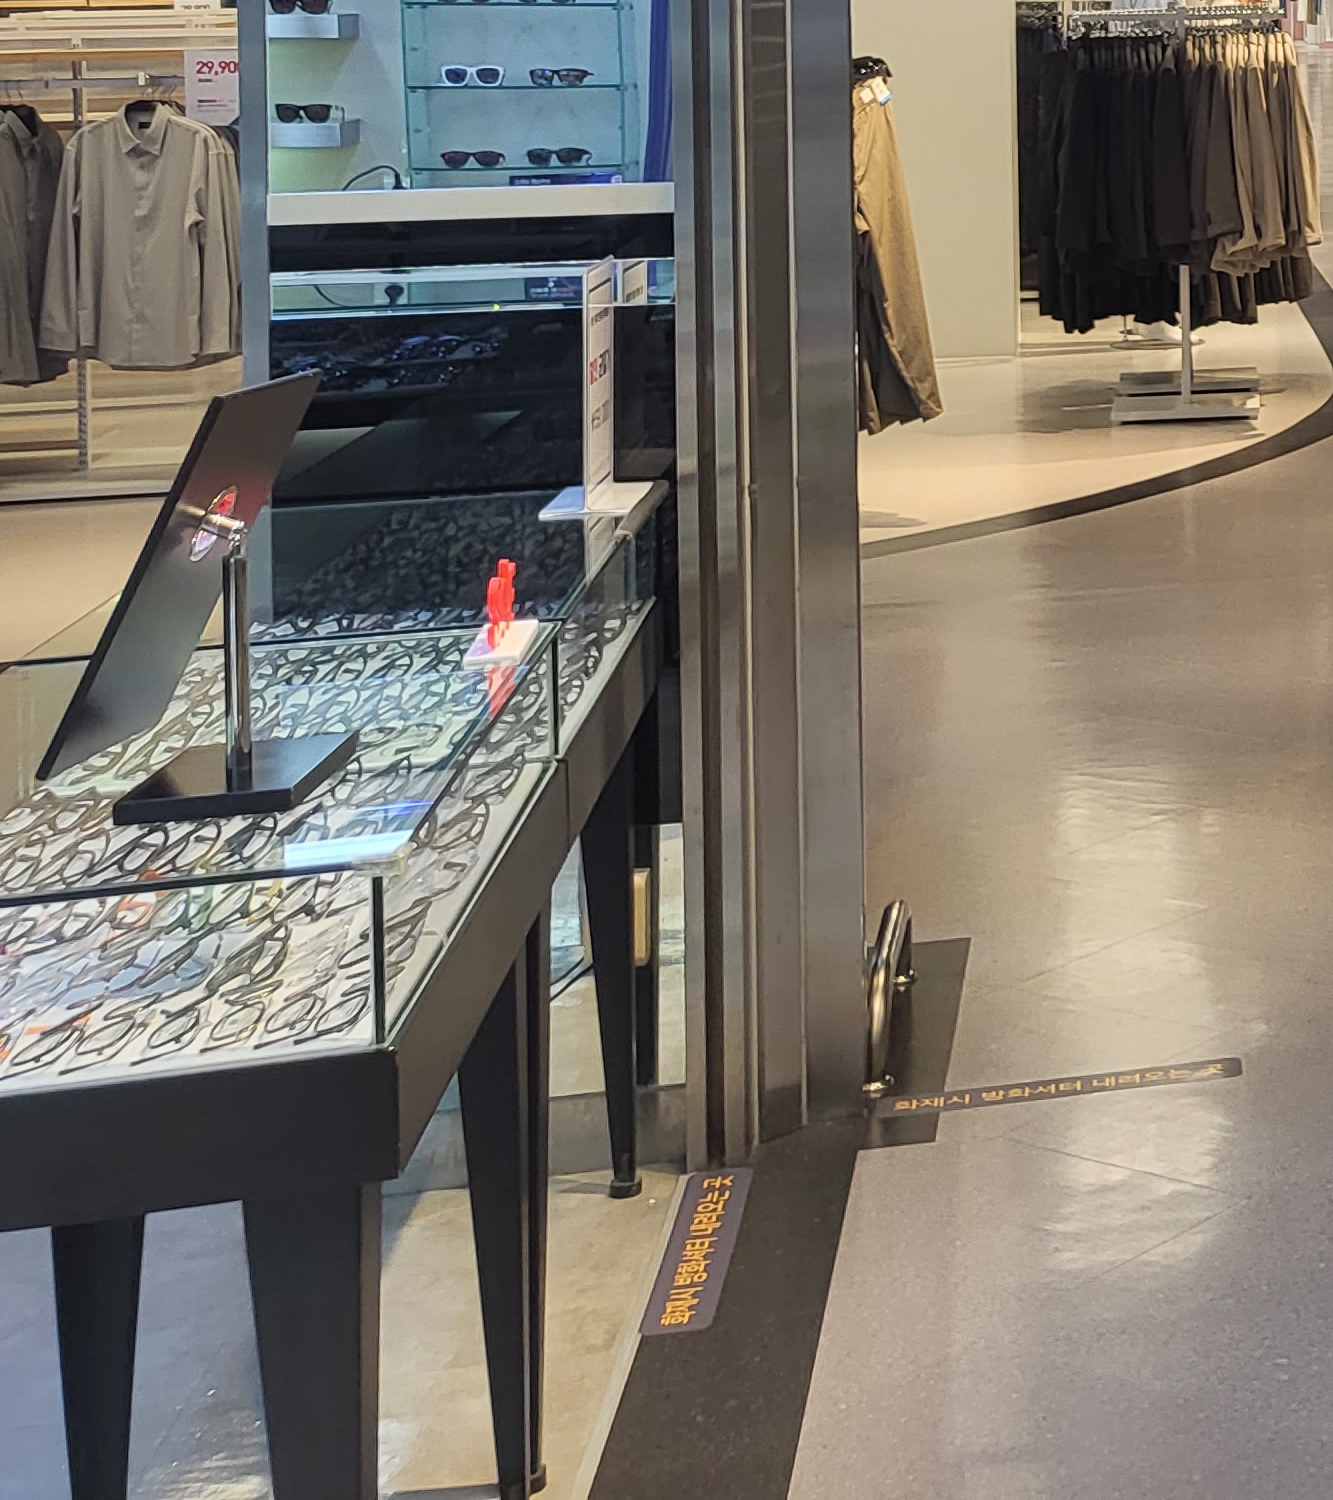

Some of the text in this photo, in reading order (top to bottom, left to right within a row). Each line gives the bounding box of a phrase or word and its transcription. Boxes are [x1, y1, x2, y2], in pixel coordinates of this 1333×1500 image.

[195, 60, 239, 76] 29,90
[893, 1092, 972, 1112] 화재시
[660, 1175, 735, 1327] 화재시 방화셔터 내려오는 곳
